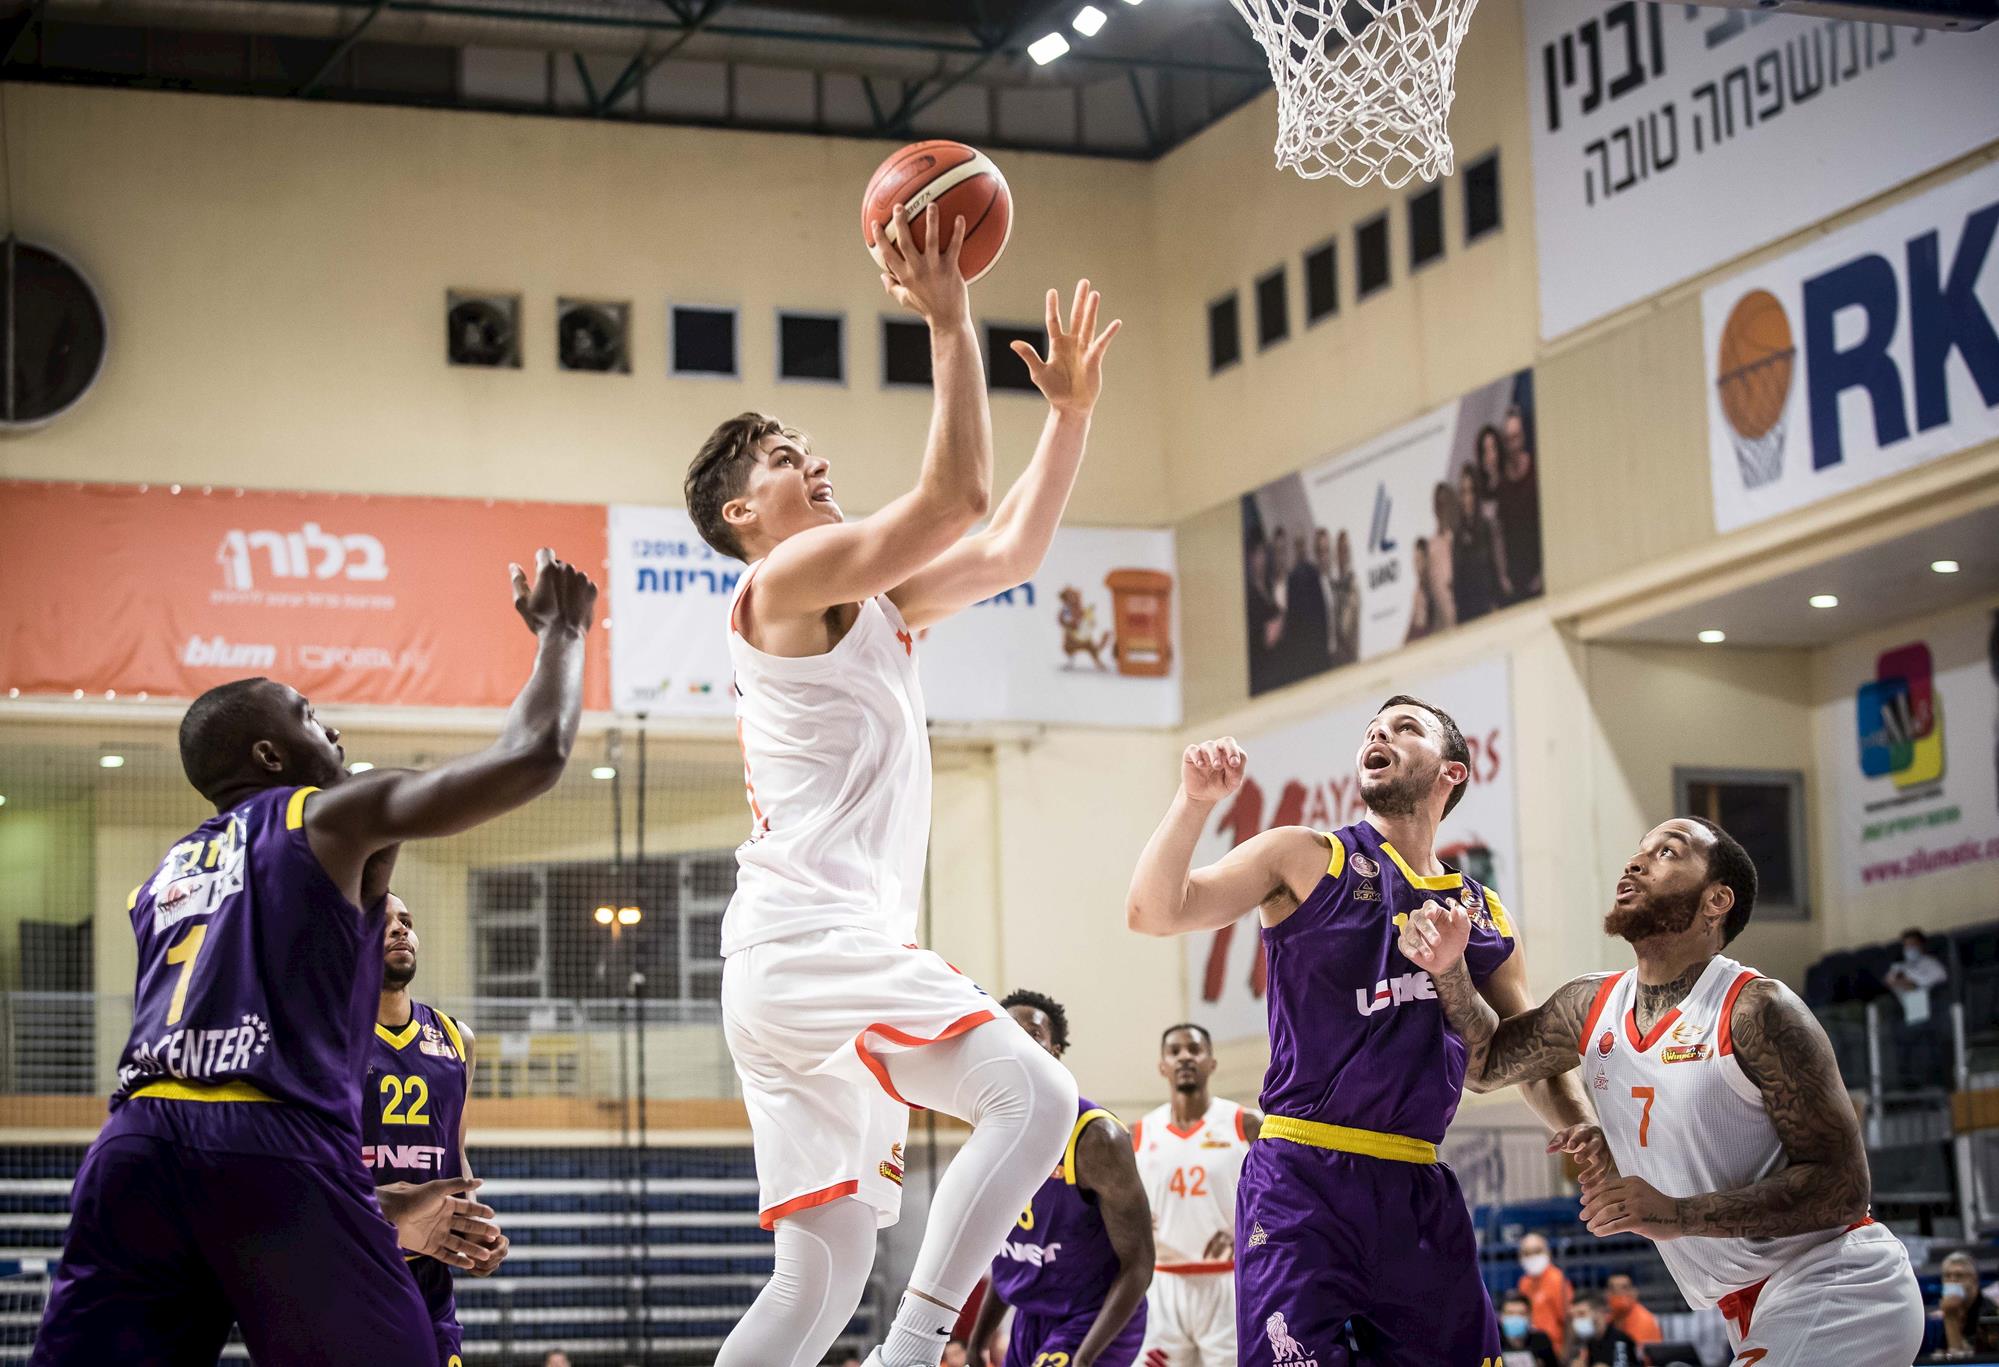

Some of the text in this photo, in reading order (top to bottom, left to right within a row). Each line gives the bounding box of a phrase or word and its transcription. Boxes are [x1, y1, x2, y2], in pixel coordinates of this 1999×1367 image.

[1584, 102, 1679, 207] טובה
[183, 634, 276, 667] blum
[1353, 890, 1382, 902] PEAK
[167, 924, 207, 1026] 1
[380, 1074, 431, 1125] 22
[1631, 1086, 1655, 1148] 7
[1169, 1166, 1207, 1198] 42
[1001, 1241, 1061, 1267] NET
